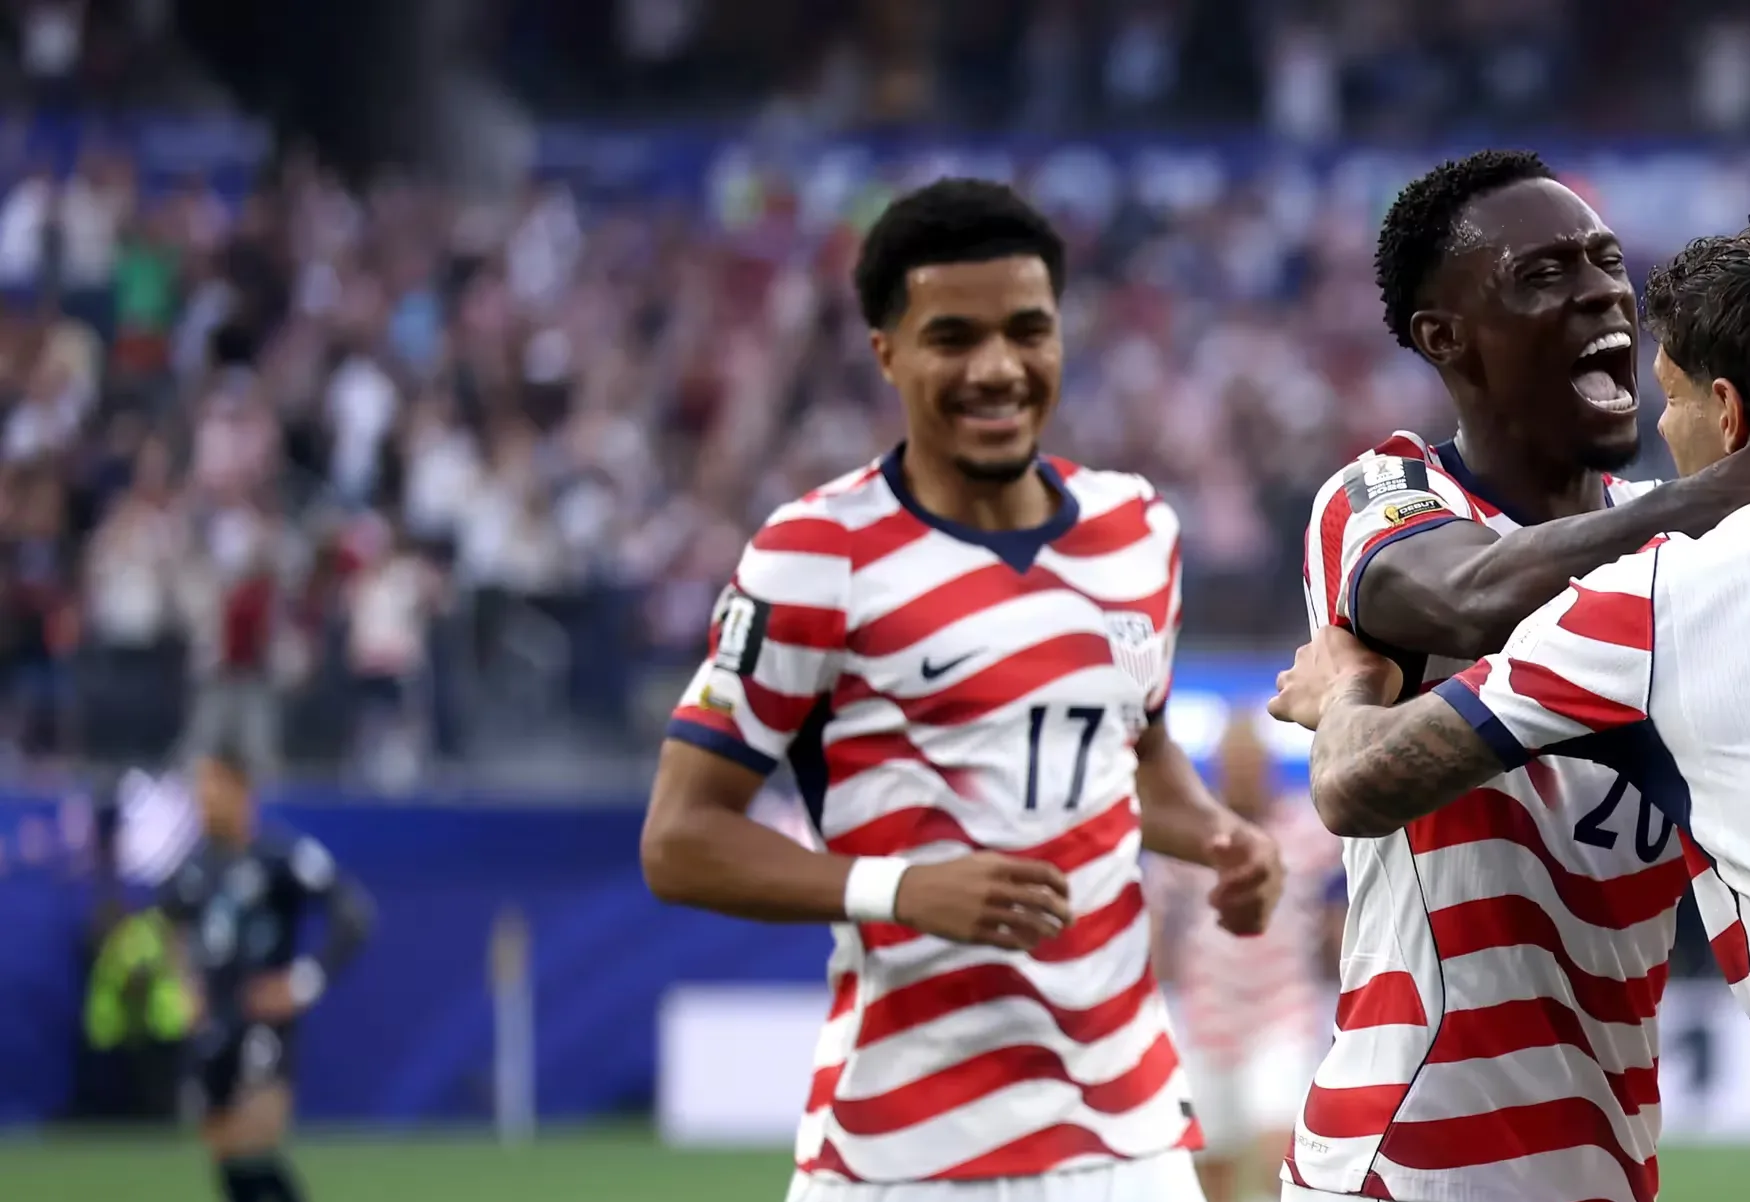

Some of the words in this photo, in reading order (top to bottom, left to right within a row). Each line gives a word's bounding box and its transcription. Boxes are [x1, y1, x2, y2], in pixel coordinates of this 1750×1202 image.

[1399, 500, 1435, 515] DEBUT
[1025, 705, 1105, 810] 17
[1573, 773, 1674, 863] 20
